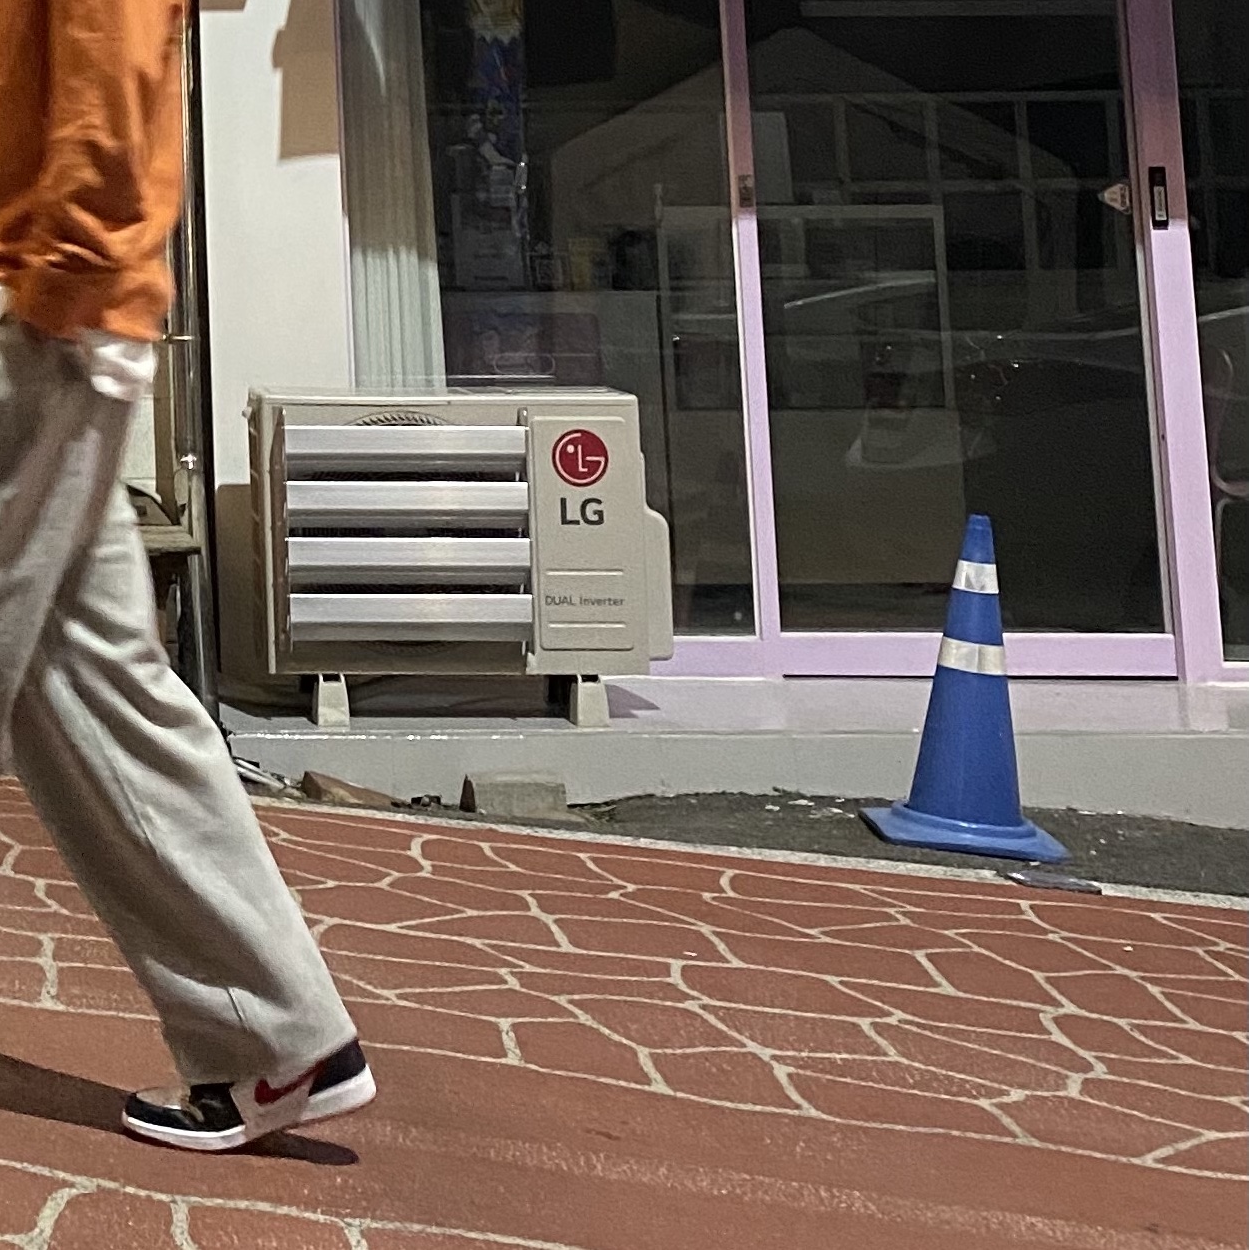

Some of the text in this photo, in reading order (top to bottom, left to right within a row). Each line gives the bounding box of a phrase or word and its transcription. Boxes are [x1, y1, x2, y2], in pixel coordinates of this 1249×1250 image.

[560, 497, 605, 526] LG
[545, 595, 625, 607] DUAL Inverter
